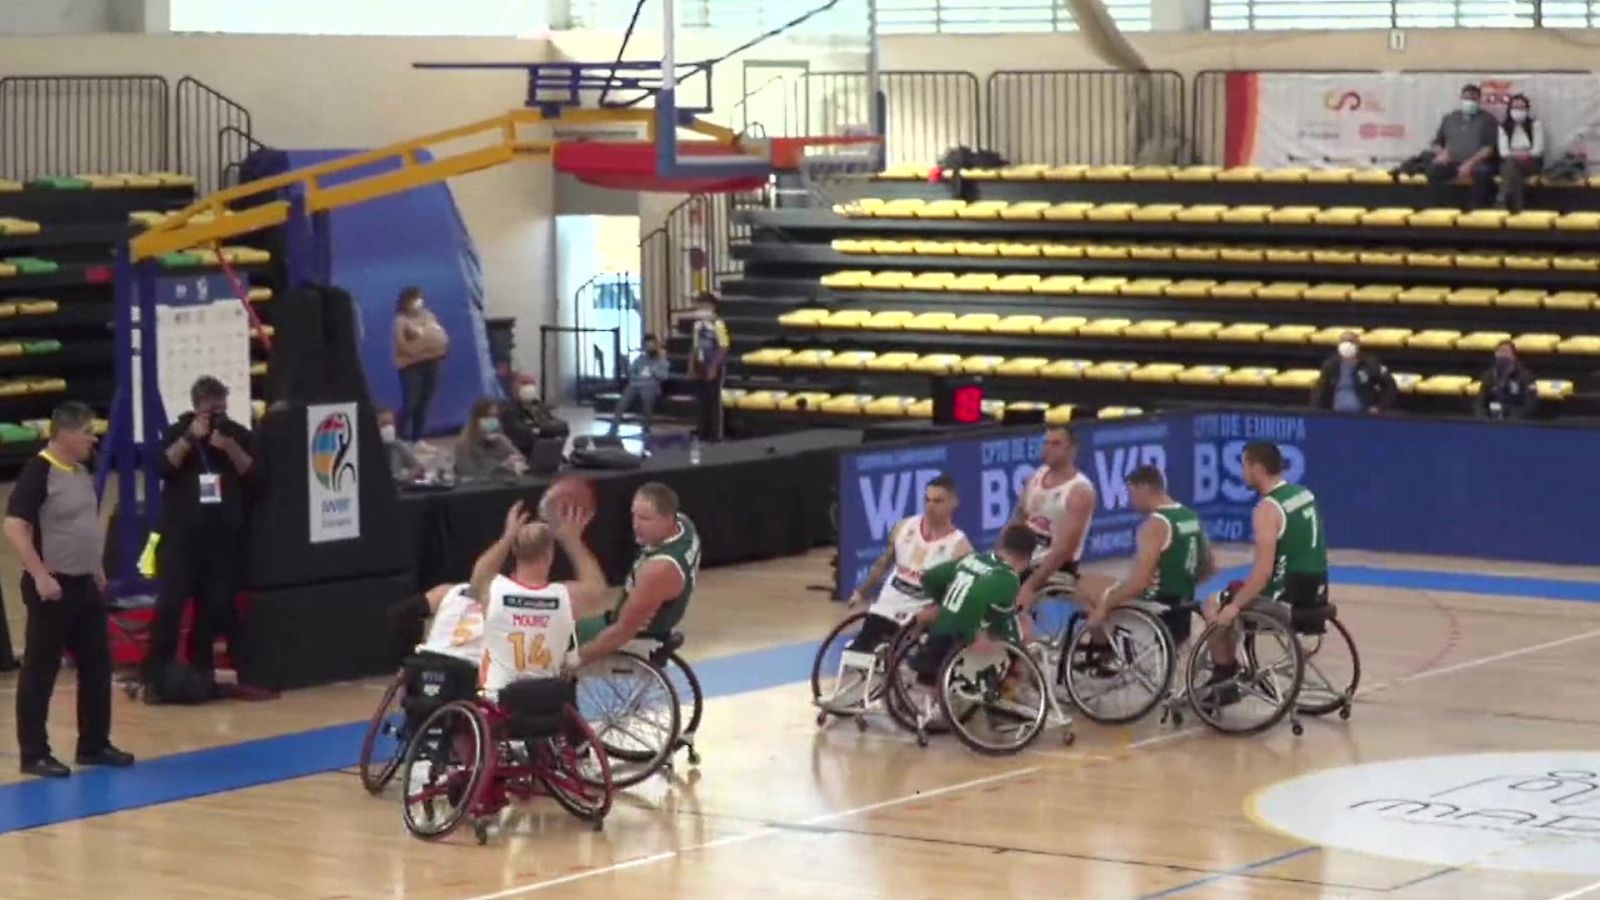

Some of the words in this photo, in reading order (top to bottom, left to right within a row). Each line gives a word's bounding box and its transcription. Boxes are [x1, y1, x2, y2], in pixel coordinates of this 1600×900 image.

[1220, 414, 1241, 438] DE
[1244, 415, 1306, 441] EUROPA
[1302, 506, 1318, 549] 7
[943, 570, 976, 614] 10
[508, 631, 553, 672] 14
